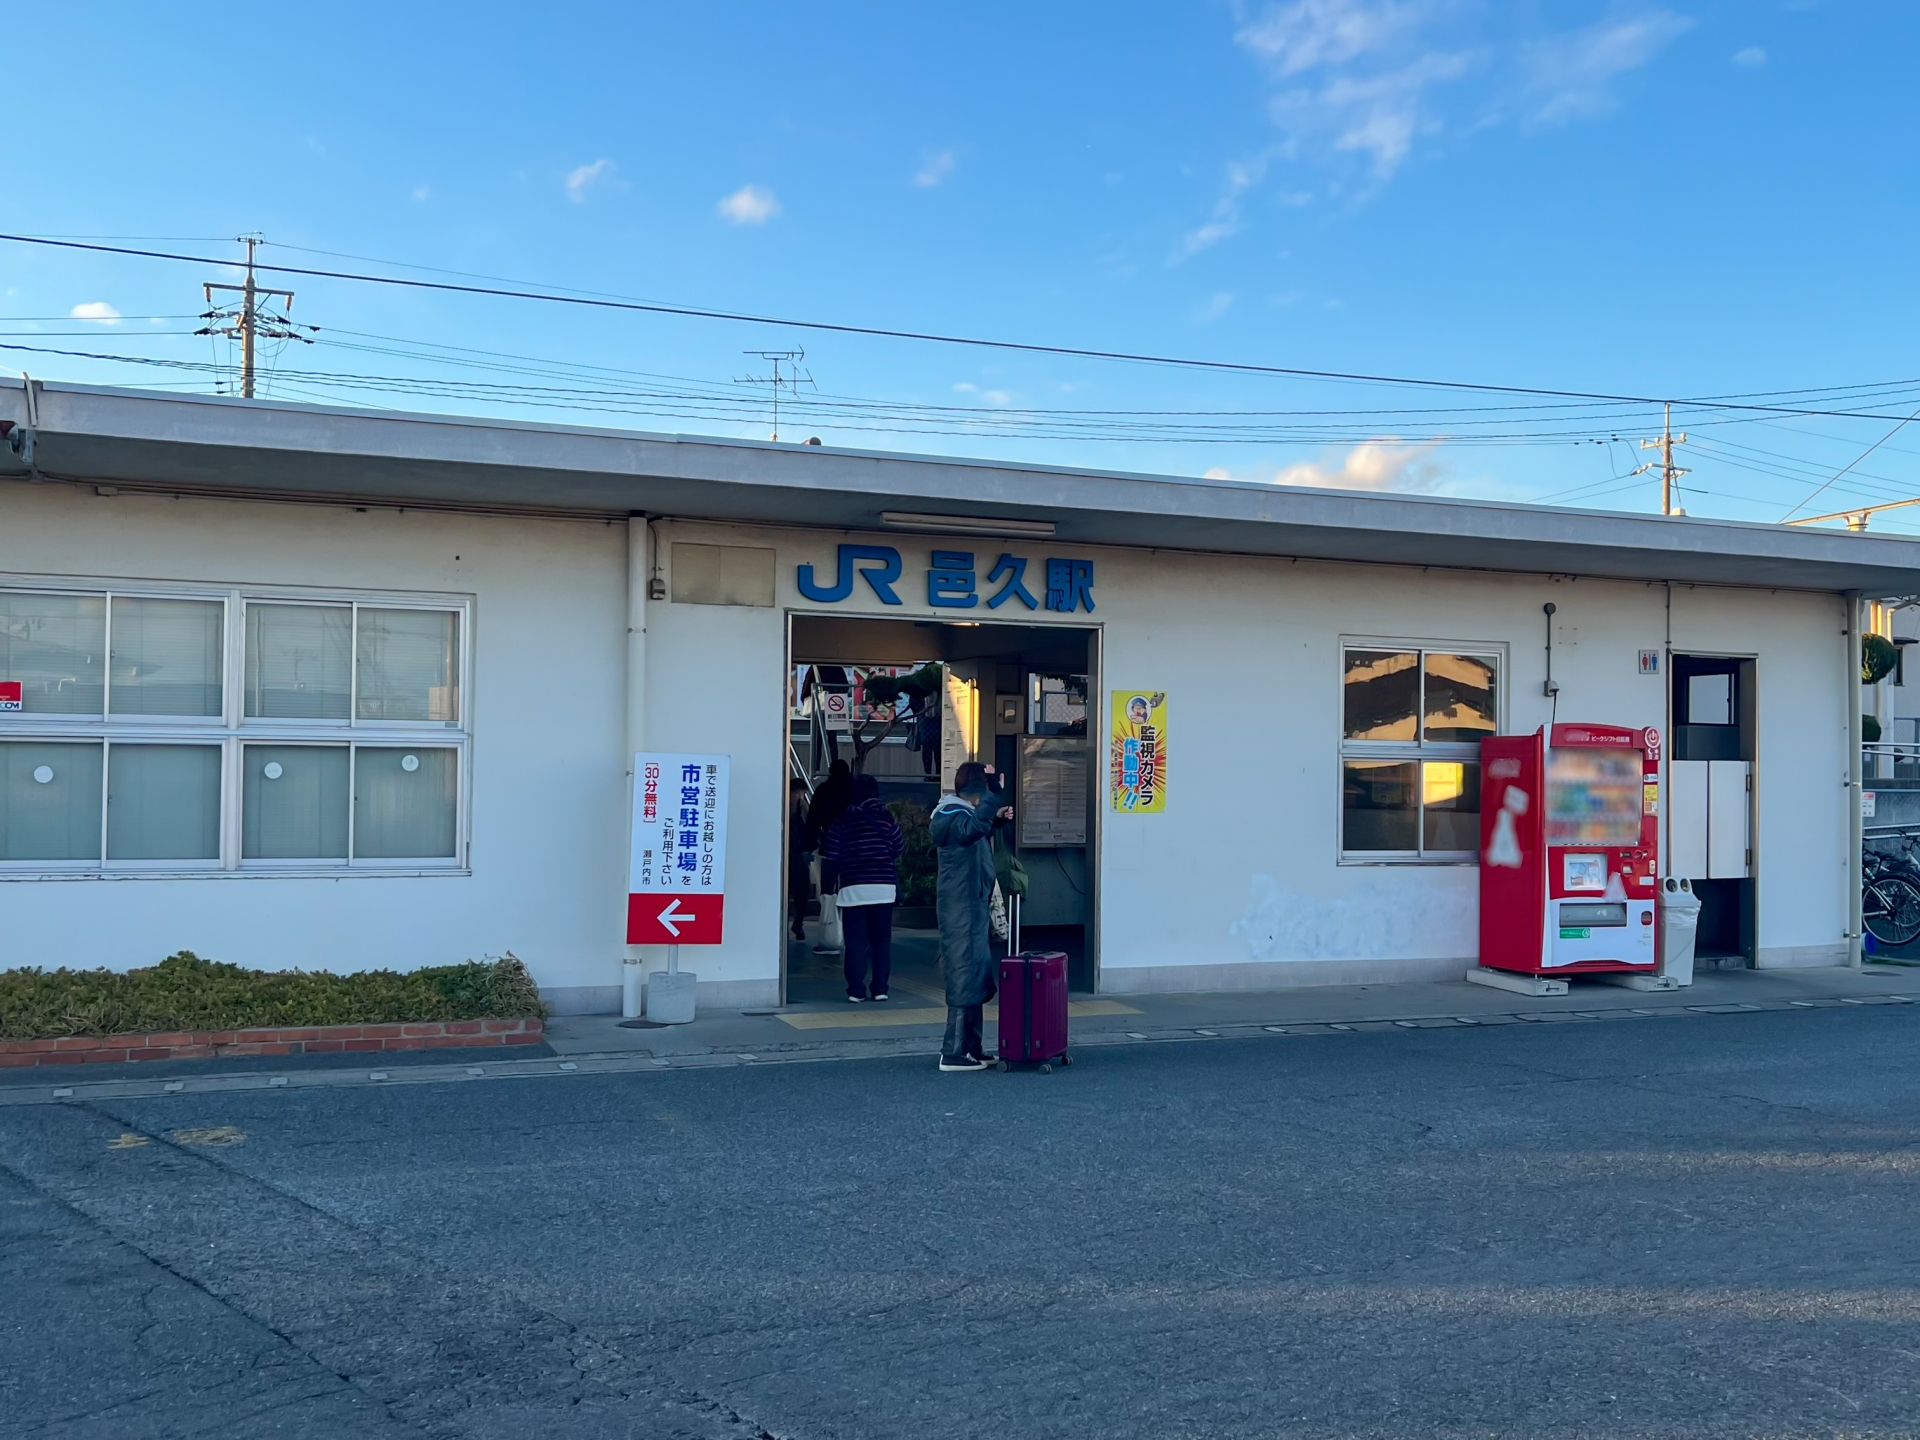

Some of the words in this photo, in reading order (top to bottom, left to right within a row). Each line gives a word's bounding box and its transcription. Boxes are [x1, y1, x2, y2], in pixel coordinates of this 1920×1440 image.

[797, 543, 903, 604] JR
[927, 550, 1096, 614] 邑久駅
[1140, 725, 1155, 806] 監視カメラ
[661, 817, 675, 886] ご利用下さい
[677, 764, 701, 885] 市営駐車場を
[701, 764, 717, 886] 車で送迎にお越しの方は
[642, 849, 652, 886] 瀬戸内市
